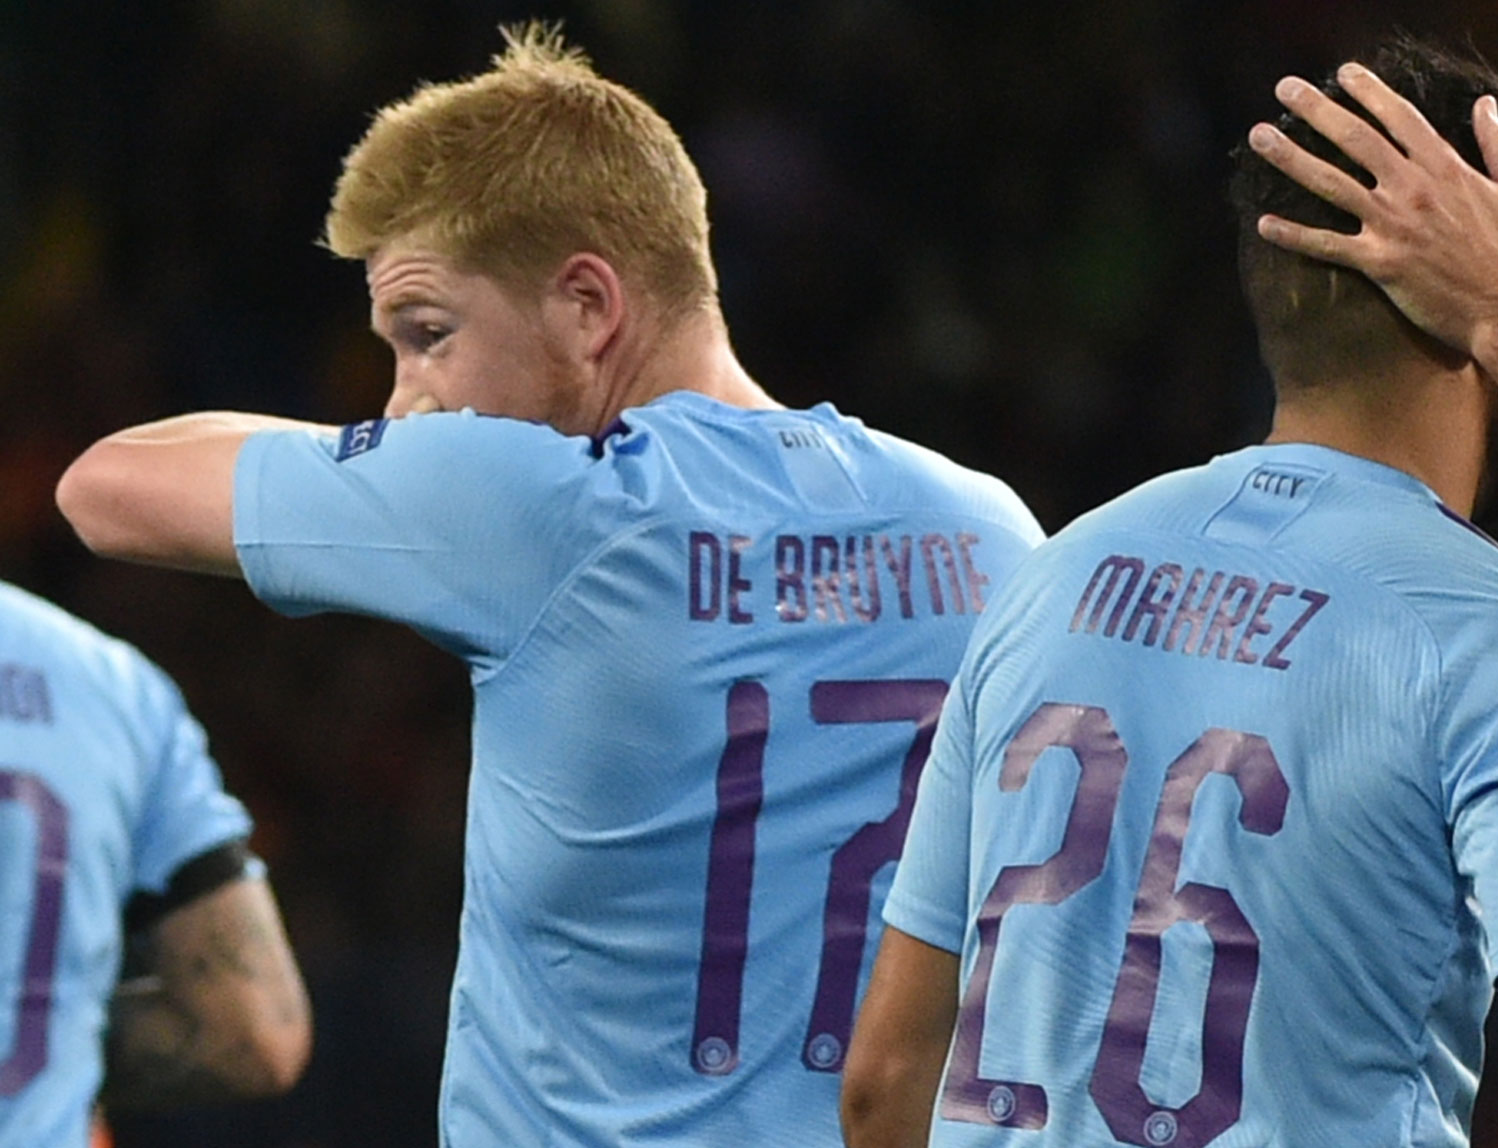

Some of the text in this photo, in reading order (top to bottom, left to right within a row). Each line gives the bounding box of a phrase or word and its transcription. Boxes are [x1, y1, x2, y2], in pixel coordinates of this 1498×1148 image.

[1252, 470, 1304, 499] CITY
[689, 531, 990, 624] DE BRUYNE
[1068, 555, 1331, 671] MAHREZ
[690, 679, 951, 1076] 17
[940, 702, 1291, 1148] 26
